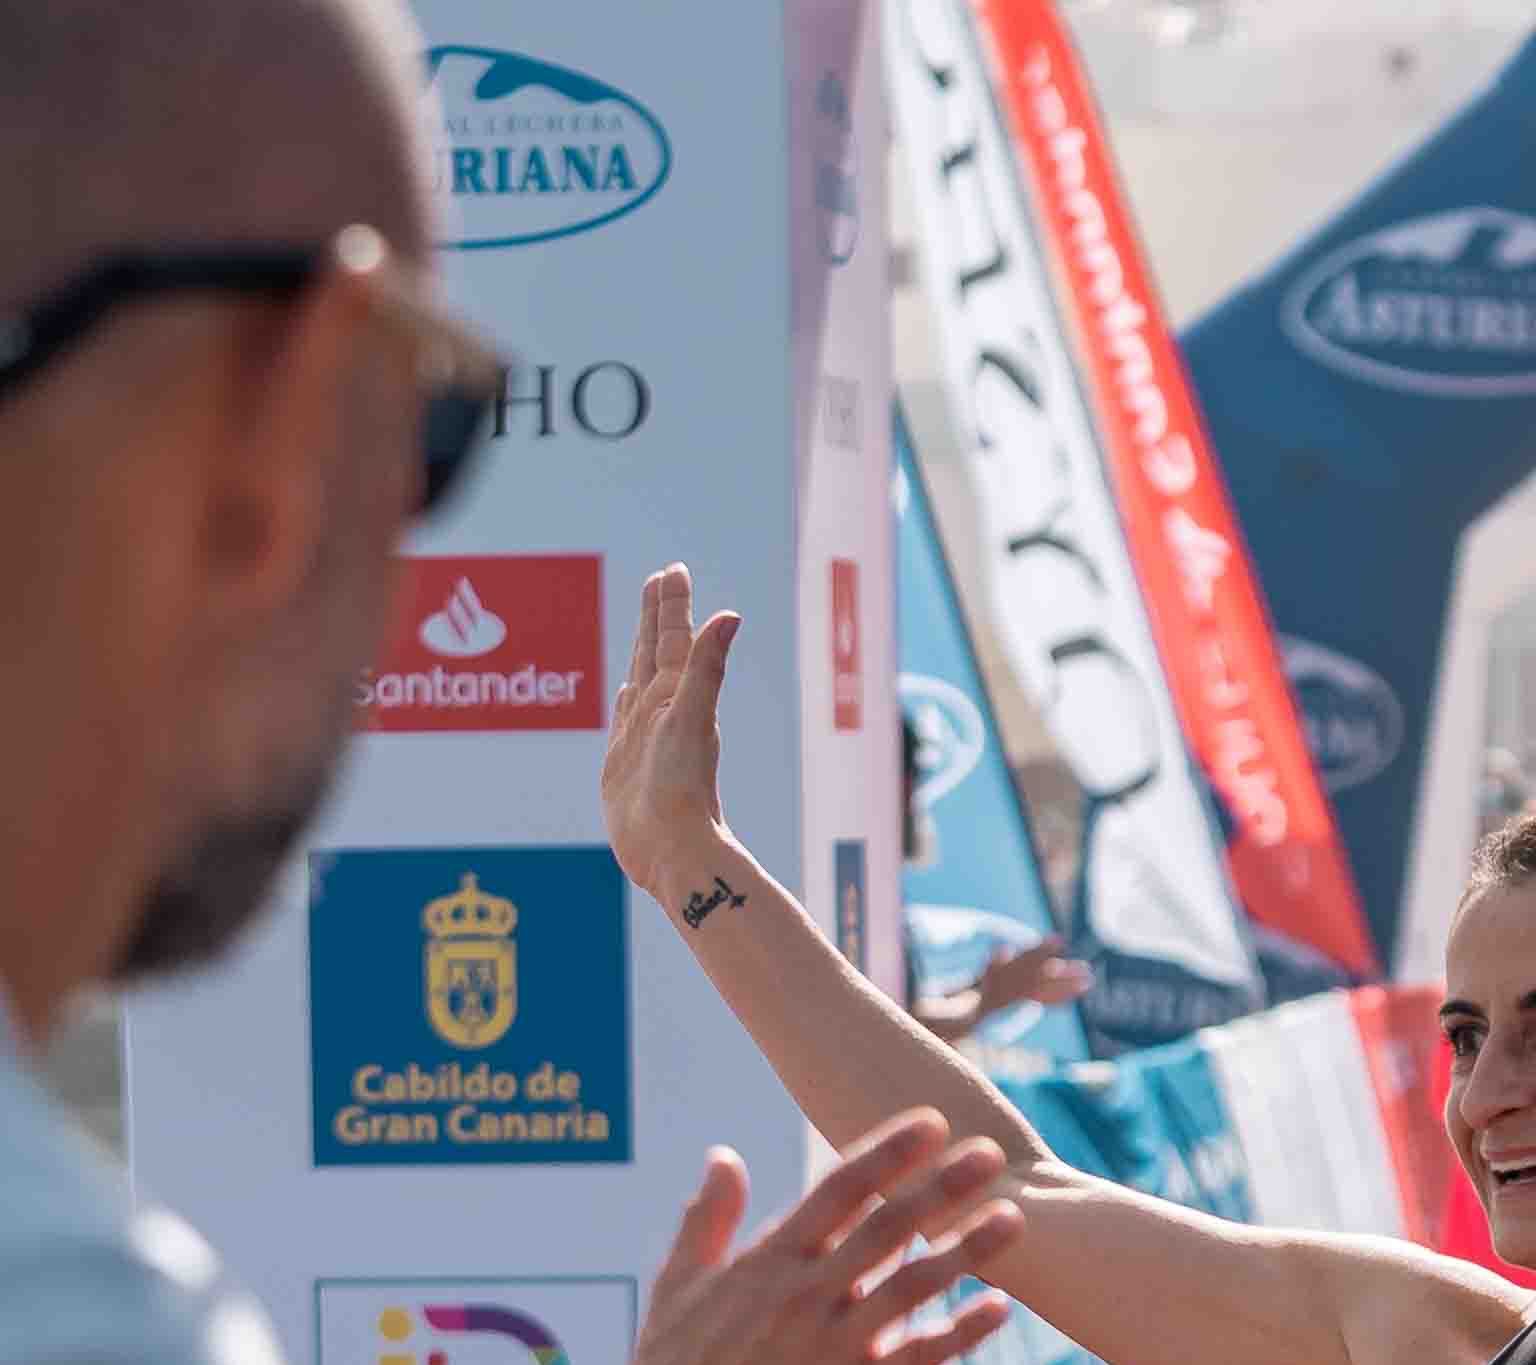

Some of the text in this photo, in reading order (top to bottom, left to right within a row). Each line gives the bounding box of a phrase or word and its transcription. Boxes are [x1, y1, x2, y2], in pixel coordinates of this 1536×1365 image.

[354, 664, 582, 707] Santander
[353, 1064, 581, 1104] Cabildo de
[333, 1103, 610, 1145] Gran Canaria
